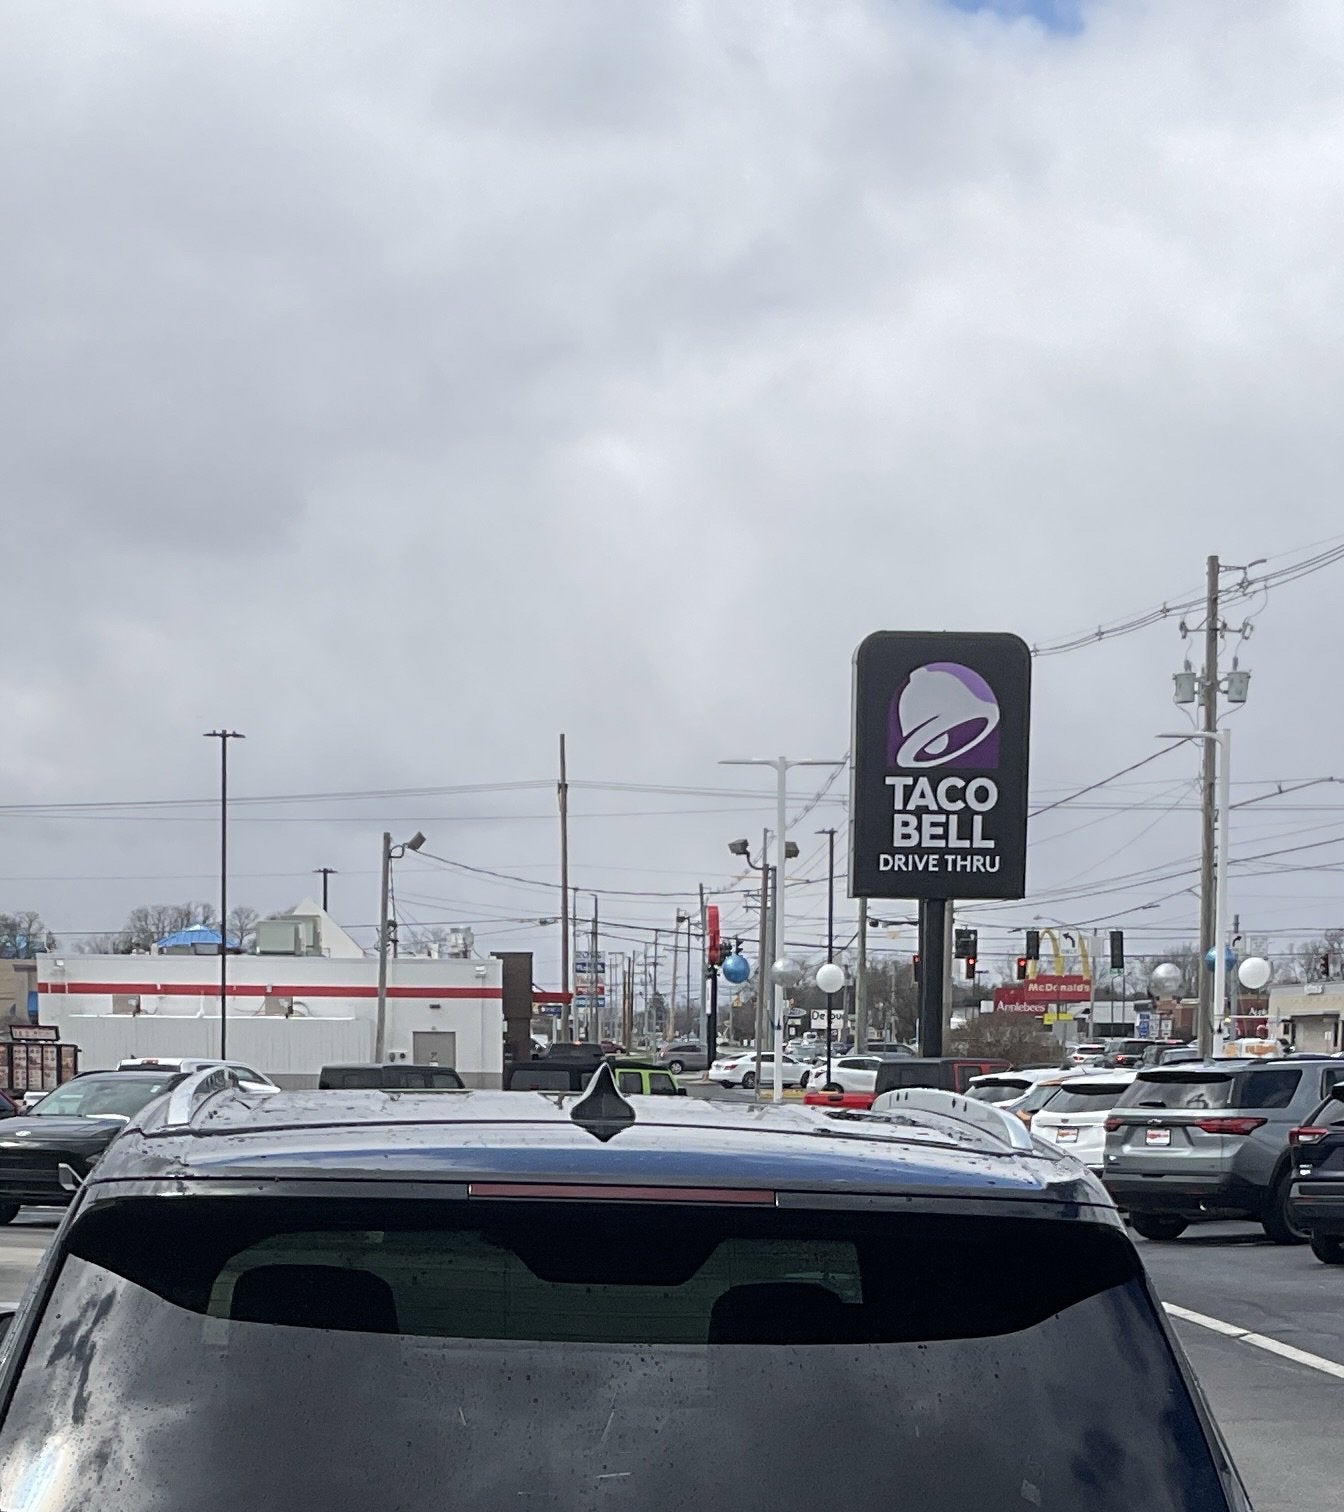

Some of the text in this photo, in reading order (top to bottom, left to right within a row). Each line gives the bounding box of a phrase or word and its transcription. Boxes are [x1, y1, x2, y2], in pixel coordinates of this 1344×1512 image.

[885, 776, 999, 811] TACO
[893, 814, 995, 849] BELL
[879, 854, 1000, 872] DRIVE THRU
